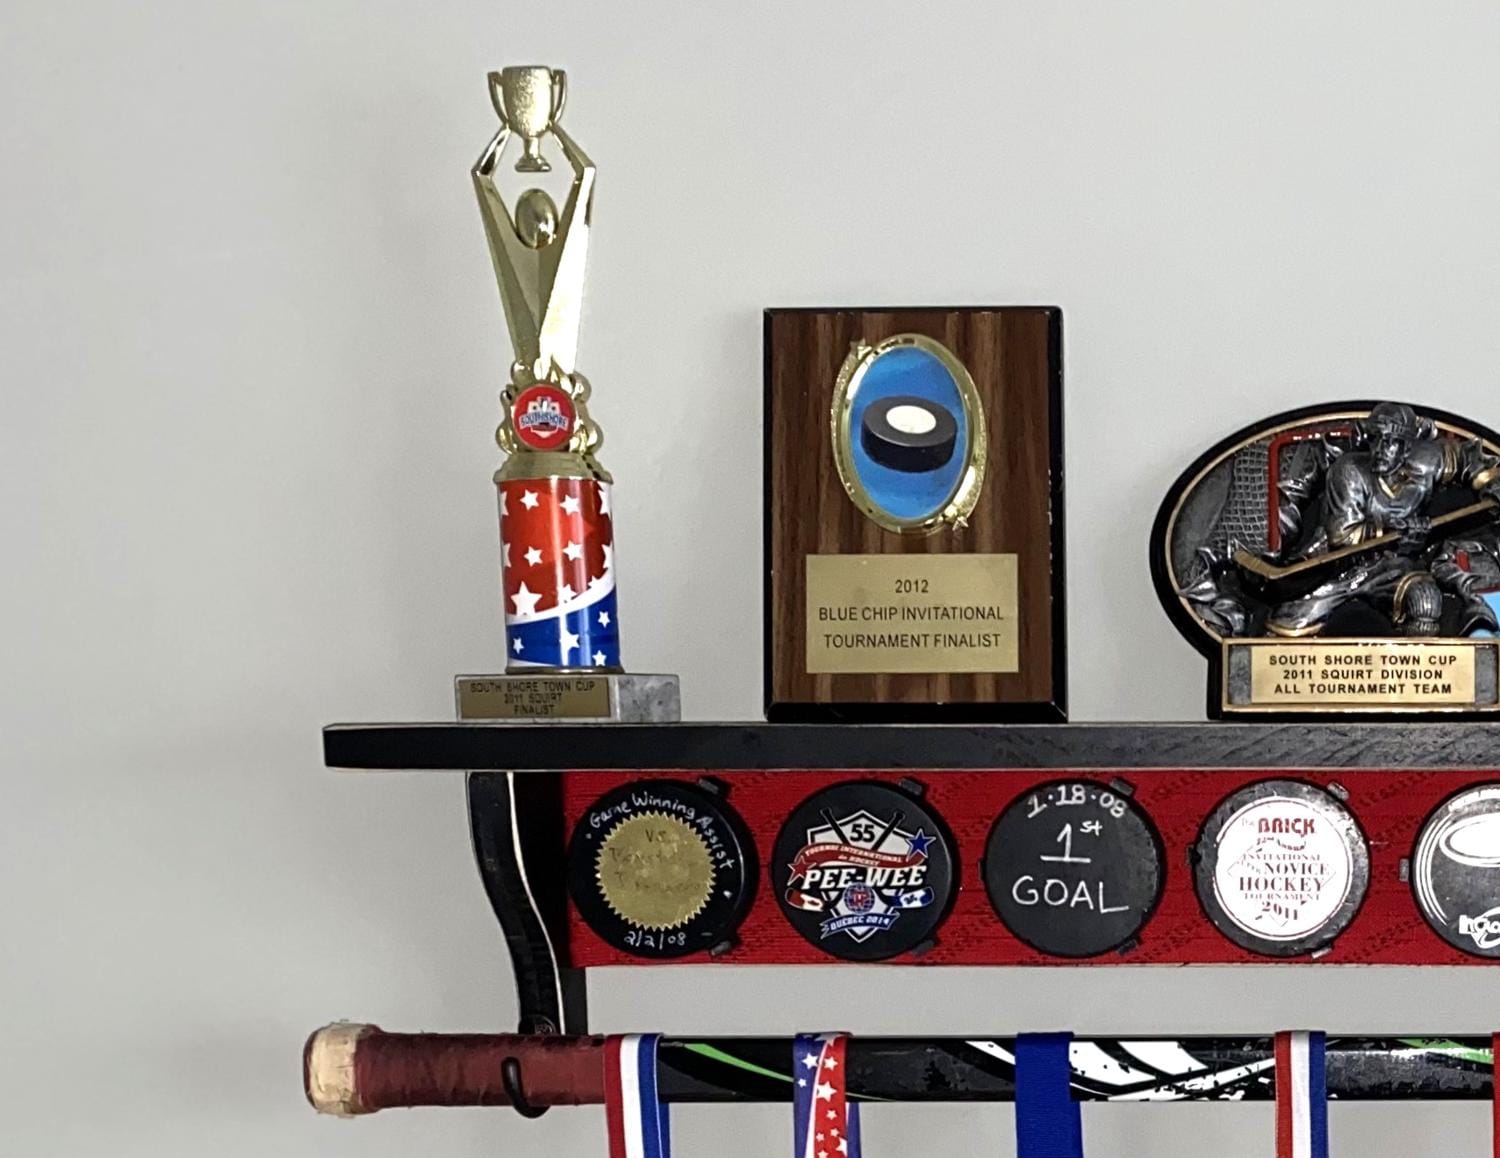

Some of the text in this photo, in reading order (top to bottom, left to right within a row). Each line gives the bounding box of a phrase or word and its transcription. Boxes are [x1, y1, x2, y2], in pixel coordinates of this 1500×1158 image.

[895, 579, 929, 593] 2012
[819, 606, 1004, 621] BLUE CHIP INVITATIONAL
[824, 633, 1001, 648] TOURNAMENT FINALIST
[1269, 655, 1457, 666] SOUTH SHORE TOWN CUP
[1283, 669, 1443, 681] 2011 SQUIRT DIVISION
[470, 681, 595, 693] SOUTH SHORE TOWN CUP
[1274, 684, 1452, 694] ALL TOURNAMENT TEAM
[513, 704, 555, 715] FINALIST
[590, 801, 631, 828] Game
[631, 791, 696, 820] Winning
[696, 815, 735, 869] Assist
[850, 823, 876, 843] 55
[1258, 817, 1315, 838] BRICK
[1264, 861, 1330, 876] NOVICE
[801, 865, 927, 890] PEE-WEE
[1239, 876, 1324, 892] HOCKEY
[1012, 875, 1129, 913] GOAL
[1244, 892, 1321, 901] TOURNAMENT
[1261, 900, 1298, 921] 2011
[866, 915, 890, 926] 2014
[624, 931, 687, 950] 2/2/08
